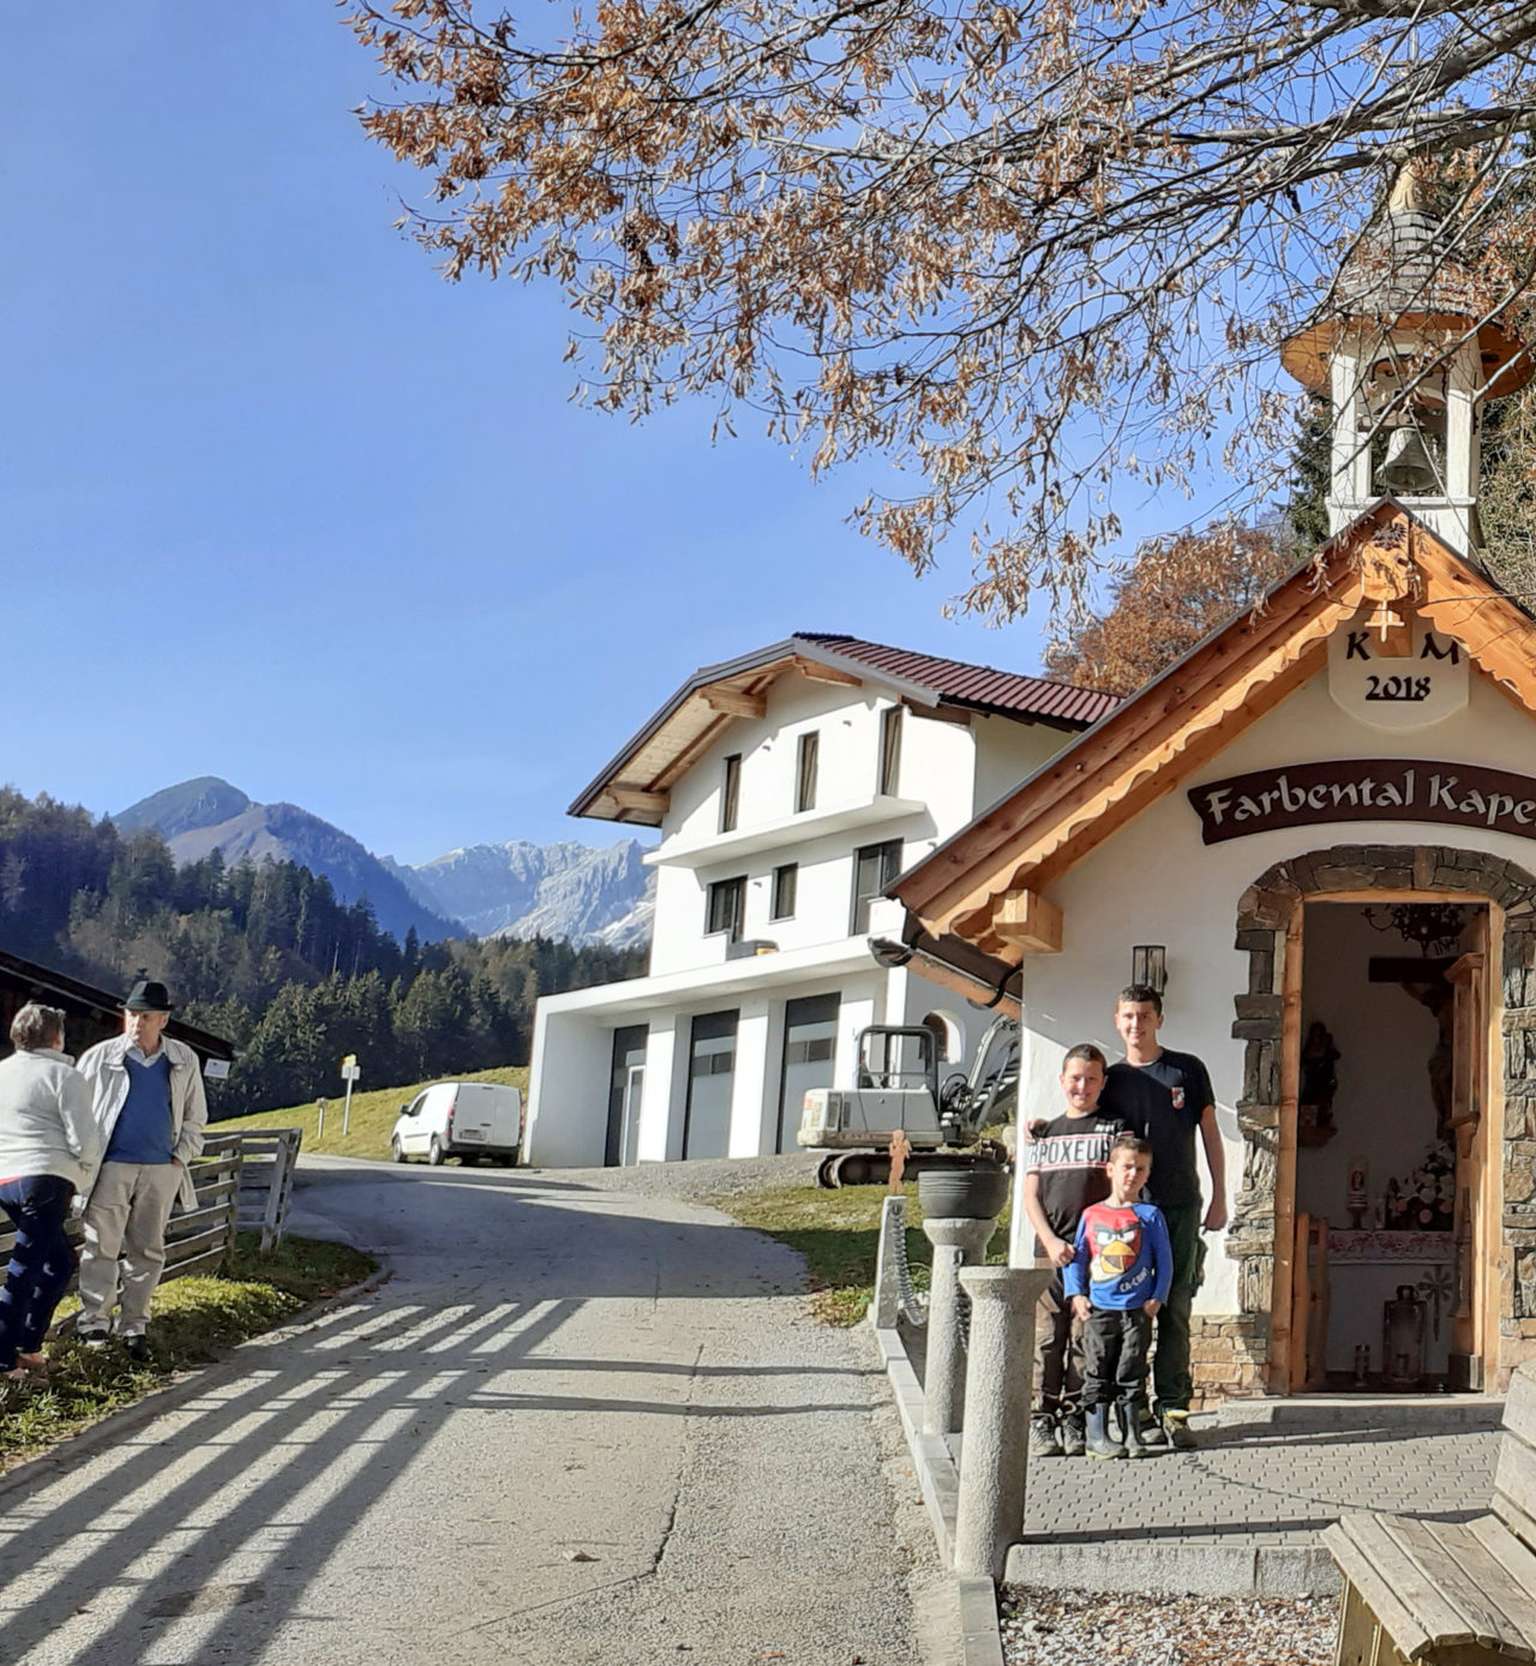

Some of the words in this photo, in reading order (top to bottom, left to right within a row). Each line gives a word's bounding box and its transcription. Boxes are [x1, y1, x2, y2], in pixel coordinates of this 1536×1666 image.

[1346, 631, 1371, 661] K
[1420, 631, 1460, 666] M
[1365, 675, 1431, 701] 2018
[1205, 769, 1415, 825] Farbental
